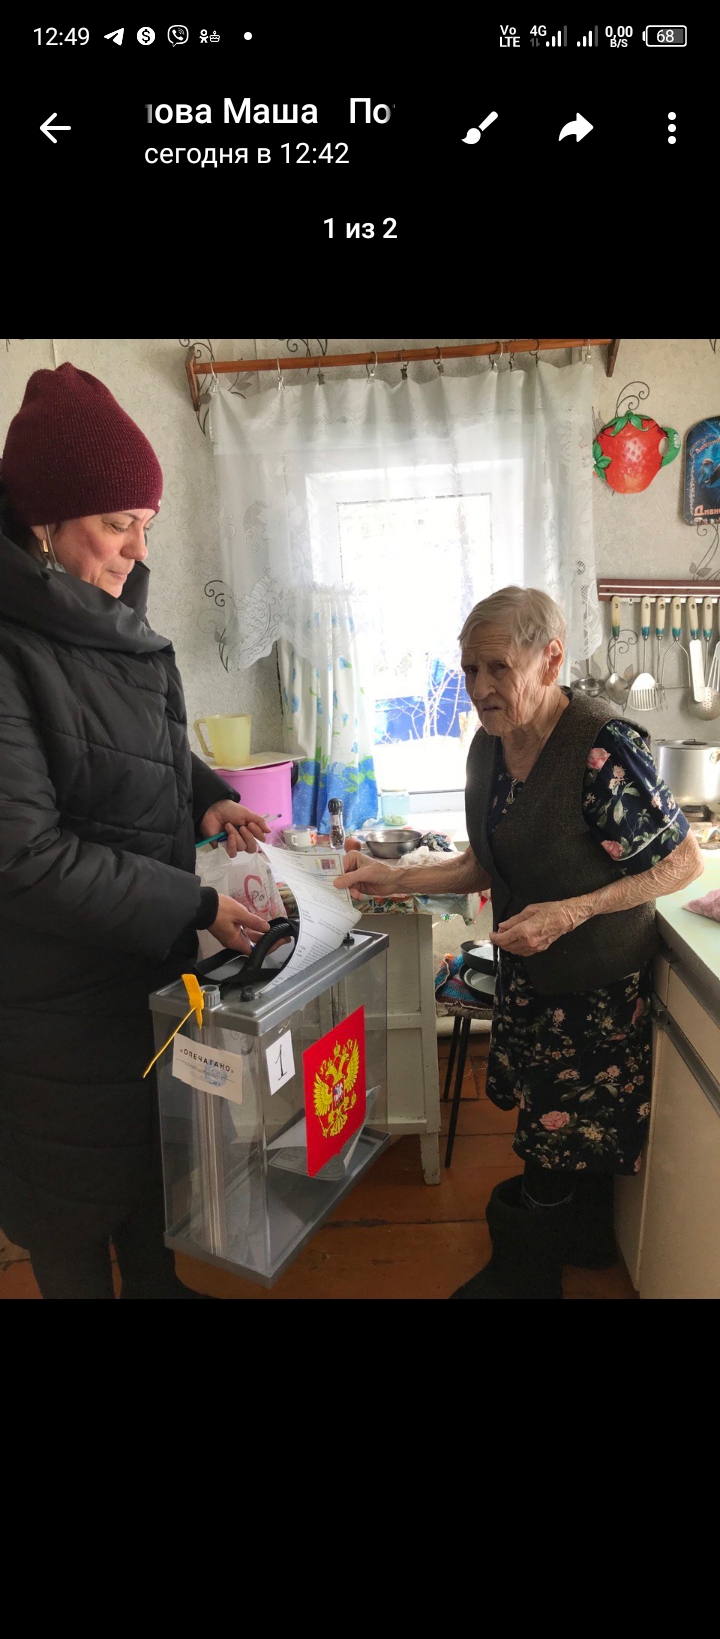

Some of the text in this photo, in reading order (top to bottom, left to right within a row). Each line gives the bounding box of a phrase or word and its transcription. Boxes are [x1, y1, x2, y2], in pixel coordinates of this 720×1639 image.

[34, 27, 89, 46] 12:49
[500, 25, 516, 35] Vo
[530, 25, 547, 36] 4G
[605, 26, 633, 39] 0,00
[656, 29, 674, 43] 68
[500, 36, 520, 47] LTE
[610, 39, 628, 48] B/S
[224, 98, 318, 124] Маша
[350, 98, 395, 124] По
[144, 142, 349, 168] сегодня в 12:42
[324, 217, 397, 239] 1 из 2
[180, 1049, 234, 1073] «ОПЕЧАТАНО»
[275, 1044, 288, 1081] 1
